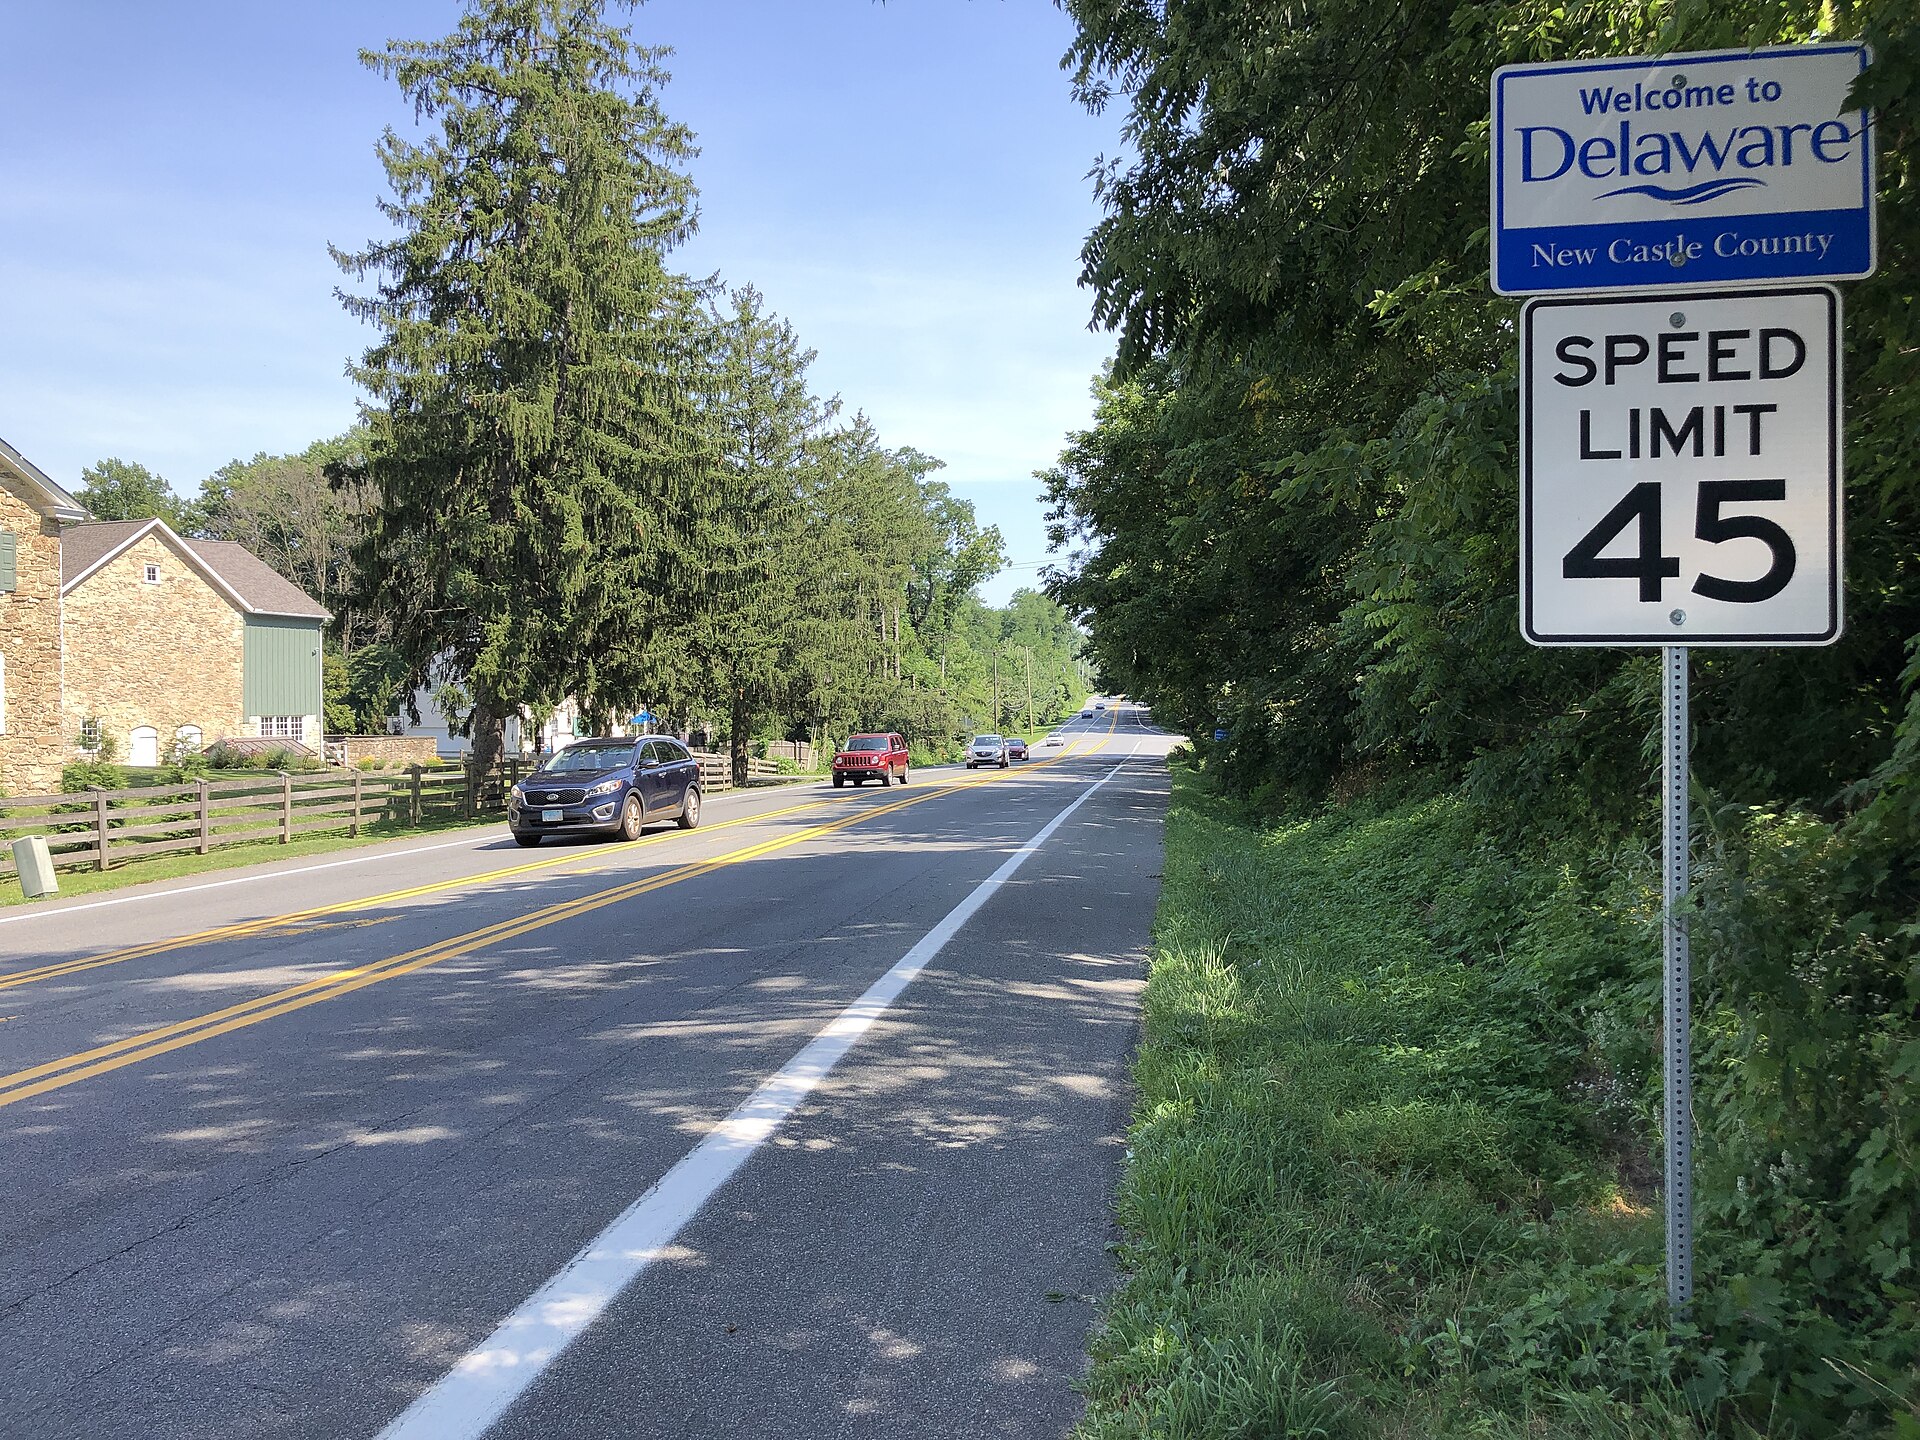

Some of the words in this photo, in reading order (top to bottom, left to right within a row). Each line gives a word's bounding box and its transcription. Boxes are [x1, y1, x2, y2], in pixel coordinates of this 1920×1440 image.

[1579, 83, 1735, 115] Welcome
[1745, 77, 1782, 103] to
[1514, 120, 1851, 184] Delaware
[1531, 243, 1598, 269] New
[1608, 234, 1703, 263] Castle
[1713, 232, 1835, 261] County
[1553, 328, 1806, 387] SPEED
[1579, 403, 1777, 460] LIMIT
[1562, 479, 1796, 603] 45
